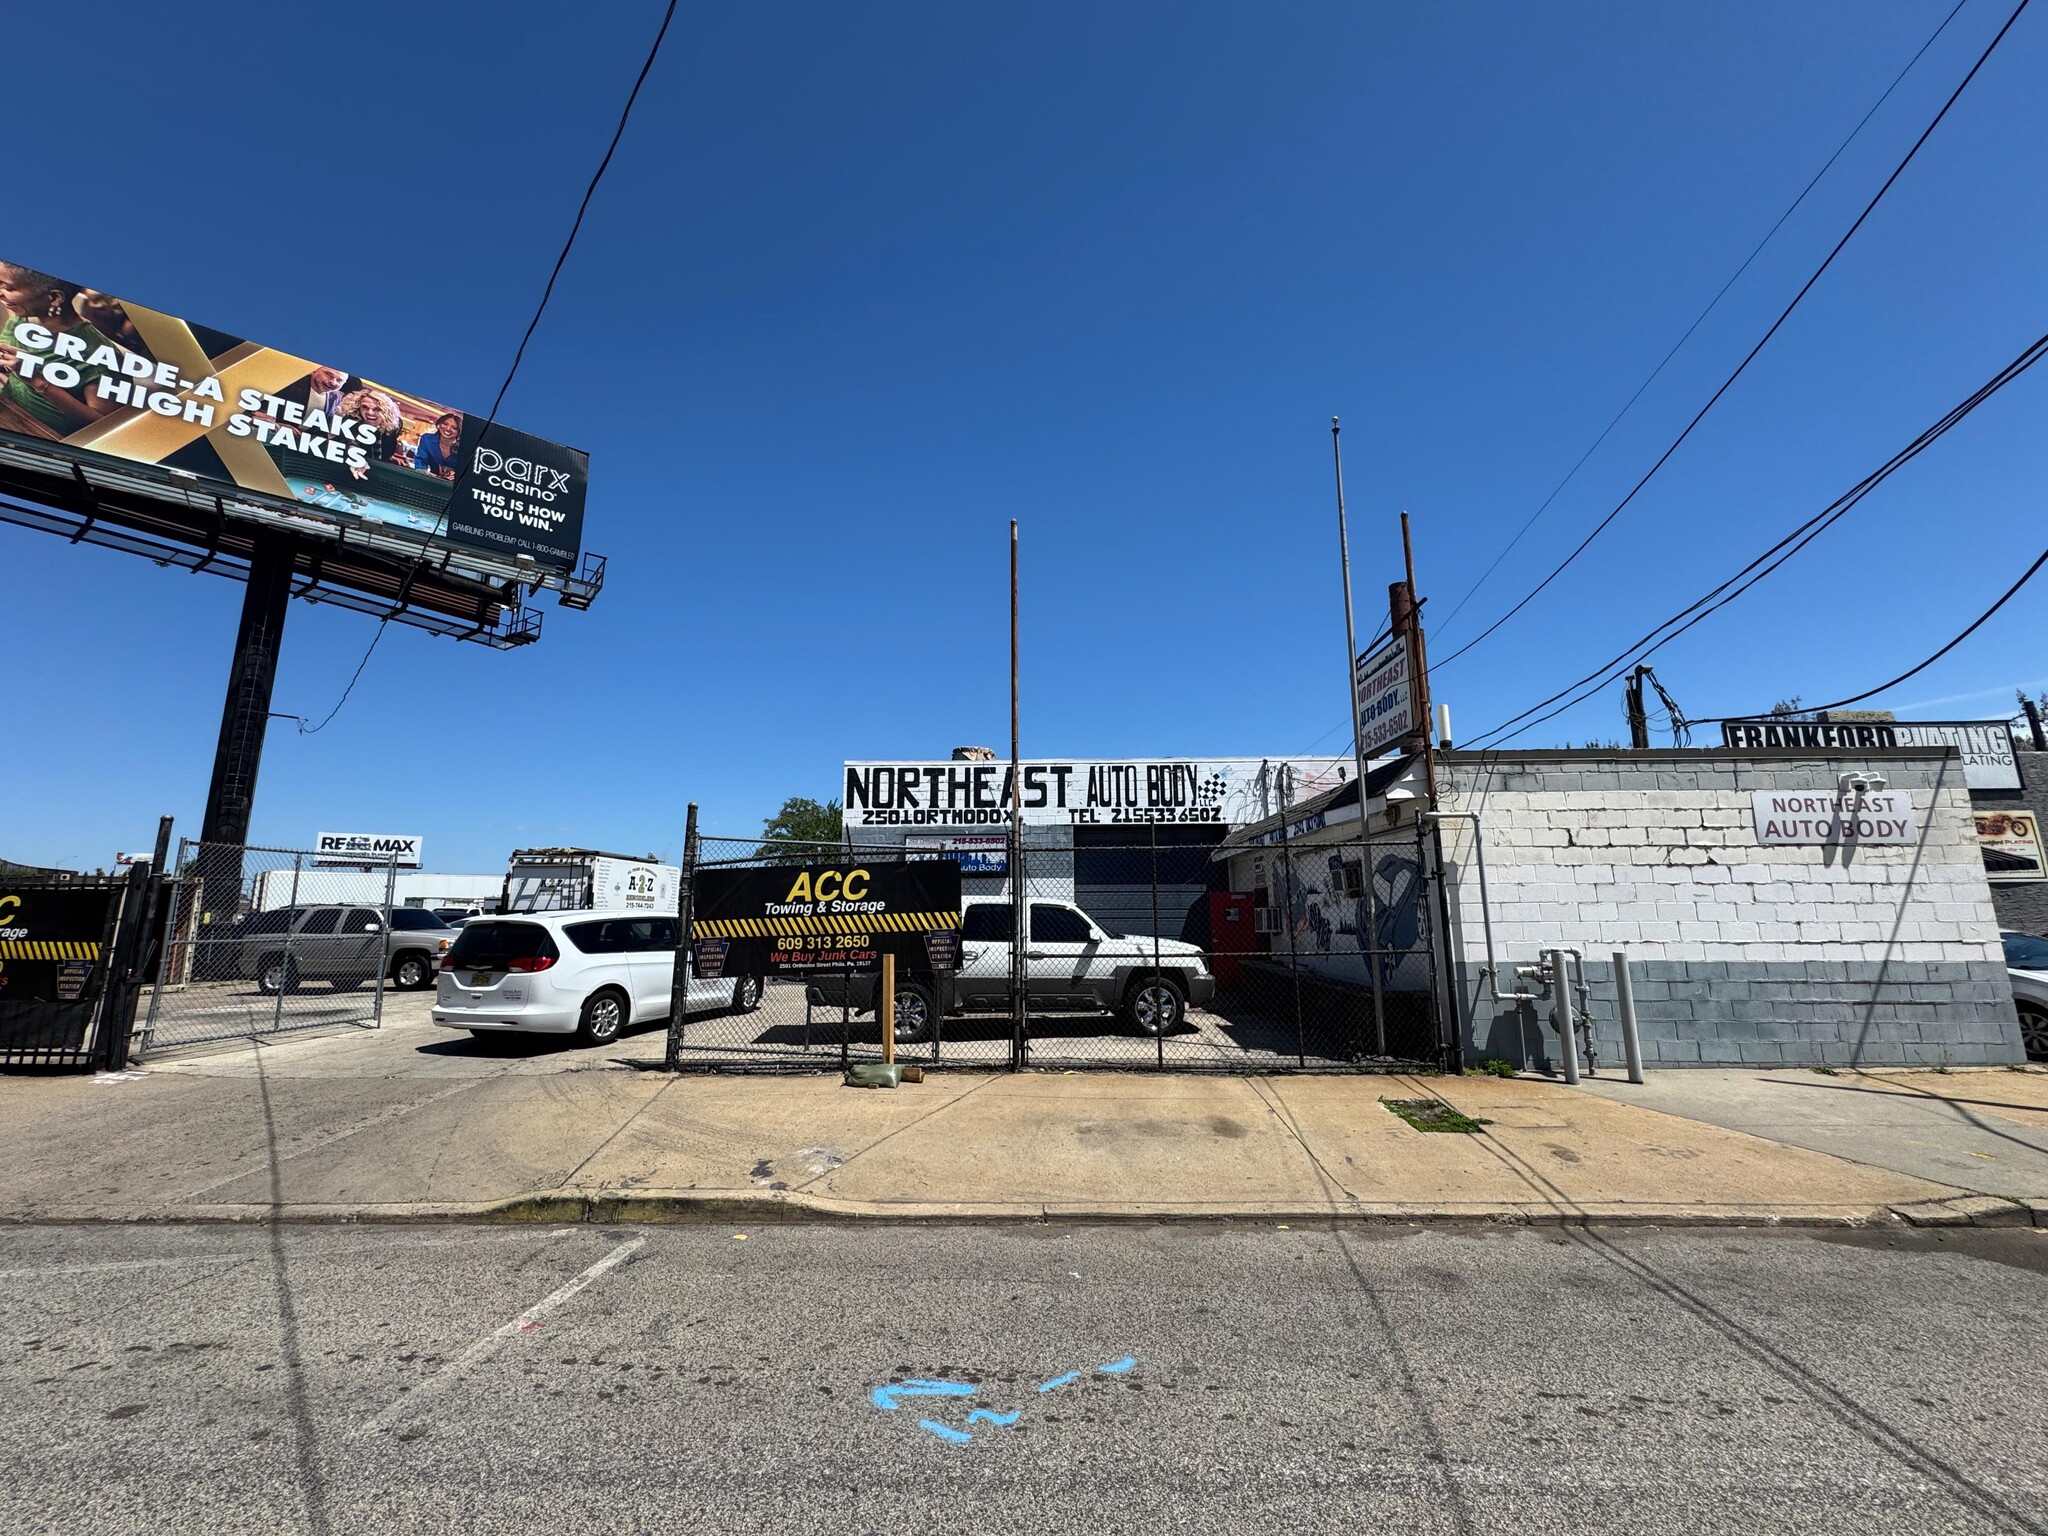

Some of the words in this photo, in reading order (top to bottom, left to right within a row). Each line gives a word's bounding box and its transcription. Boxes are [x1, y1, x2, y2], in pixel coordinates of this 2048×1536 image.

[14, 322, 224, 402] GRADE-A
[238, 388, 378, 445] STEAKS
[16, 351, 81, 388] TO
[97, 375, 215, 428] HIGH
[227, 413, 367, 468] STAKES
[473, 446, 571, 493] parx
[488, 475, 555, 502] casino
[472, 488, 506, 507] THIS
[510, 499, 524, 512] IS
[528, 504, 566, 523] HOW
[481, 503, 514, 521] YOU
[518, 513, 554, 532] WIN.
[452, 522, 484, 537] GAMBLING
[485, 530, 517, 546] PROBLEM?
[518, 538, 531, 549] CALL
[532, 542, 575, 560] 1-800-GAMBLER
[1359, 657, 1406, 704] ORTHEAST
[1360, 705, 1376, 729] UTO
[1400, 691, 1408, 702] LLC
[1728, 725, 1896, 748] FRANKFORD
[1961, 756, 2013, 766] LATING
[846, 766, 1073, 809] NORTHEAST
[1087, 766, 1137, 807] AUTO
[1147, 765, 1197, 807] BODY
[1200, 798, 1212, 806] LLC
[1772, 797, 1894, 813] NORTHEAST
[1765, 820, 1832, 838] AUTO
[1841, 819, 1908, 838] BODY
[373, 839, 415, 852] MAX
[979, 863, 1002, 872] Body
[785, 869, 870, 902] ACC
[765, 902, 813, 916] Towing
[817, 901, 827, 913] &
[831, 900, 885, 914] Storage
[770, 952, 788, 962] We
[792, 951, 815, 964] Buy
[818, 950, 846, 960] Junk
[850, 949, 877, 960] Cars
[777, 937, 803, 950] 609
[807, 936, 832, 949] 313
[836, 935, 870, 948] 2650
